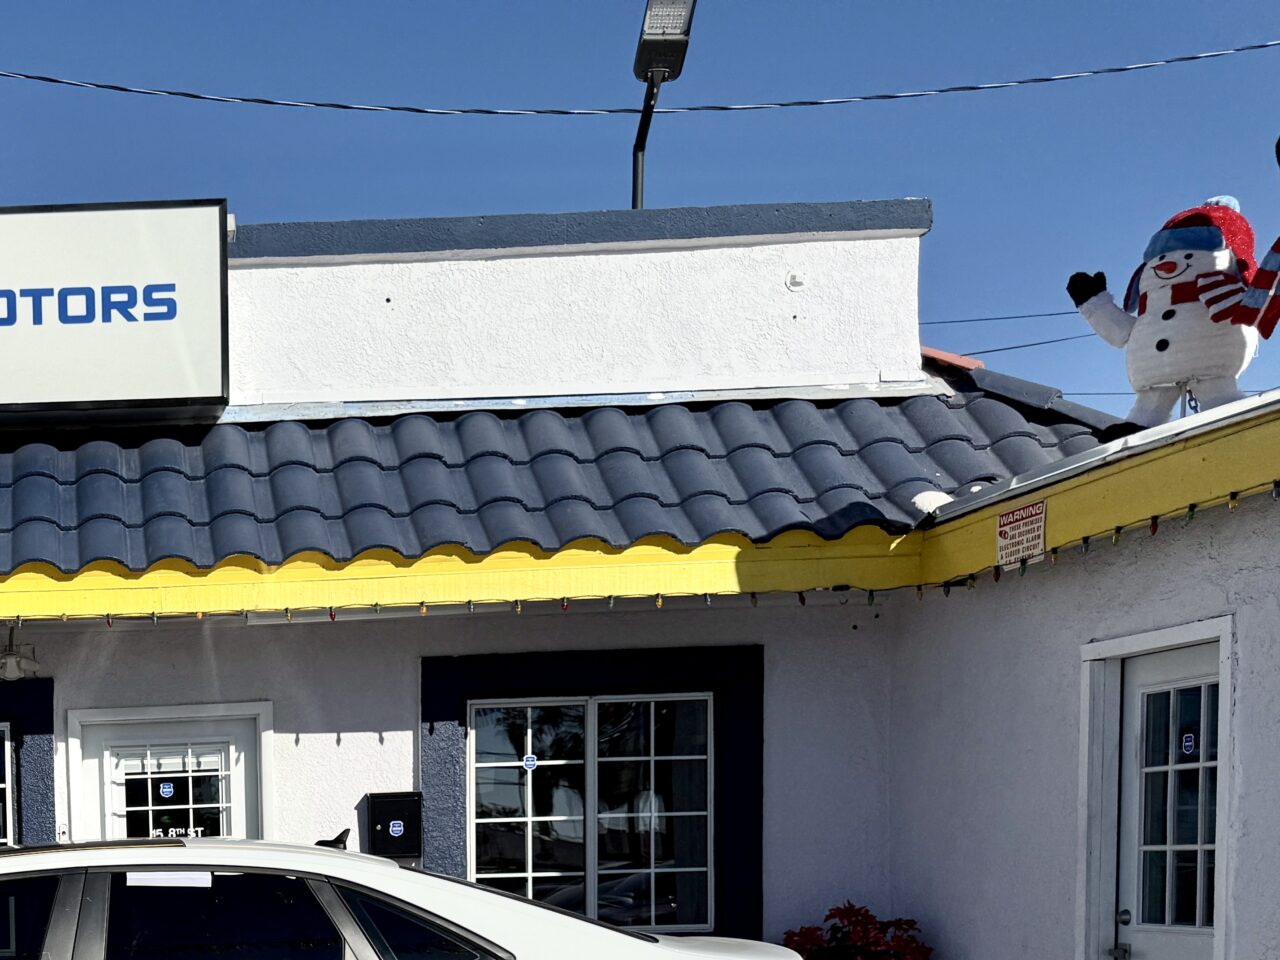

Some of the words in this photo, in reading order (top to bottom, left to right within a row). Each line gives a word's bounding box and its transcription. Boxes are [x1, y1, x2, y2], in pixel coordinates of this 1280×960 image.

[1000, 503, 1042, 525] WARNING
[1026, 534, 1041, 543] ALARM
[1021, 542, 1040, 553] CIRCUIT
